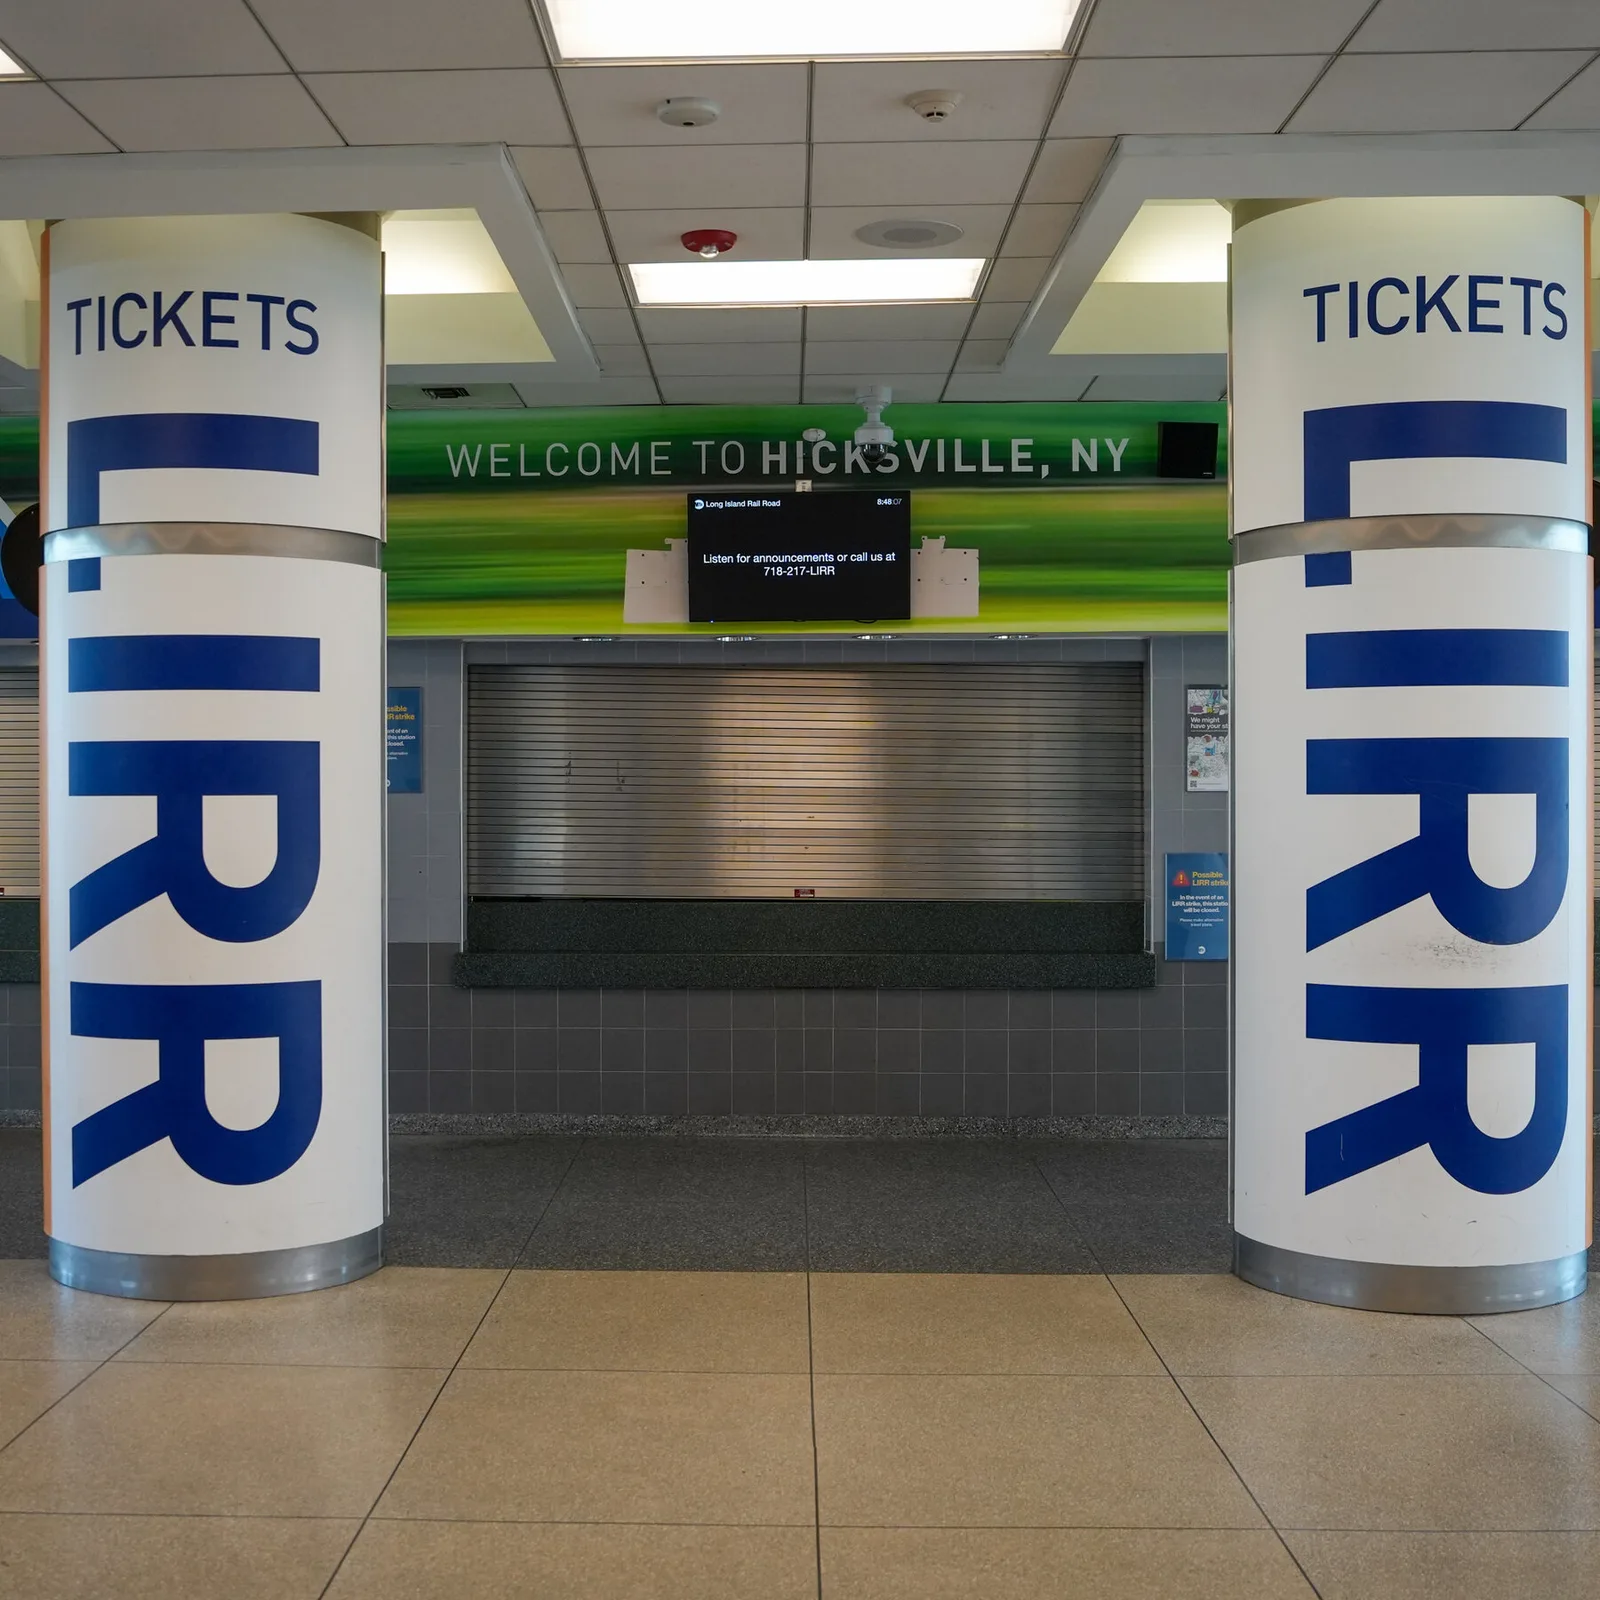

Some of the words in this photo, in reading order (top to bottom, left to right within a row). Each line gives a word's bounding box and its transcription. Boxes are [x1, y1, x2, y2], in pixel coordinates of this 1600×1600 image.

[67, 291, 320, 355] TICKETS
[1303, 274, 1568, 343] TICKETS
[446, 441, 672, 478] WELCOME
[692, 440, 746, 475] TO
[1071, 438, 1130, 472] NY
[706, 501, 724, 509] Long
[703, 554, 734, 563] Listen
[736, 554, 750, 563] for
[753, 553, 834, 563] announcements
[850, 552, 868, 562] call
[871, 554, 883, 562] us
[885, 553, 896, 562] at
[763, 566, 836, 577] 718-217-LIRR
[67, 413, 322, 1189] LIRR
[1303, 400, 1570, 1195] LIRR
[1192, 871, 1224, 879] Possible
